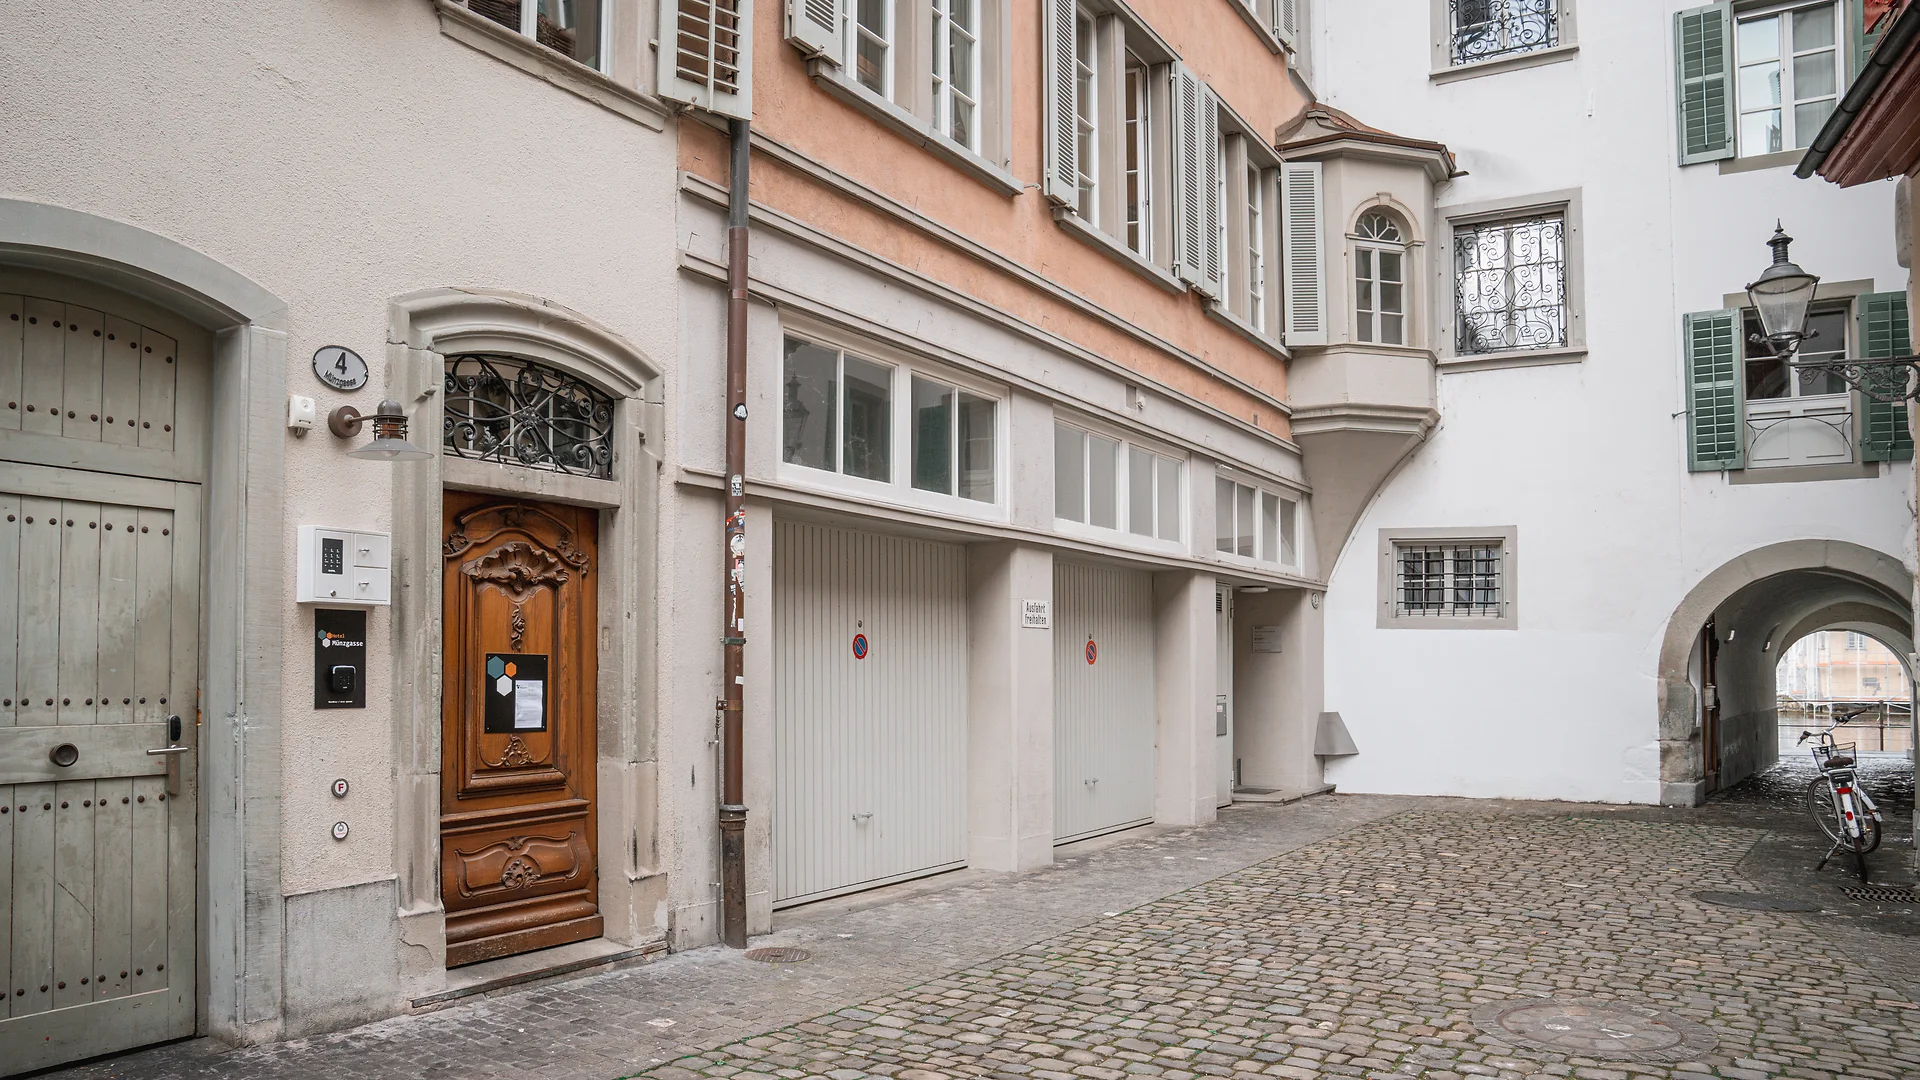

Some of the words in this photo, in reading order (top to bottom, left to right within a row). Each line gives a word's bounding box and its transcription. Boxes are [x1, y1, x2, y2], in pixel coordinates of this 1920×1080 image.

[334, 351, 347, 375] 4
[1026, 601, 1046, 614] Ausfahrt
[332, 639, 364, 648] Münzgasse
[337, 783, 344, 792] F
